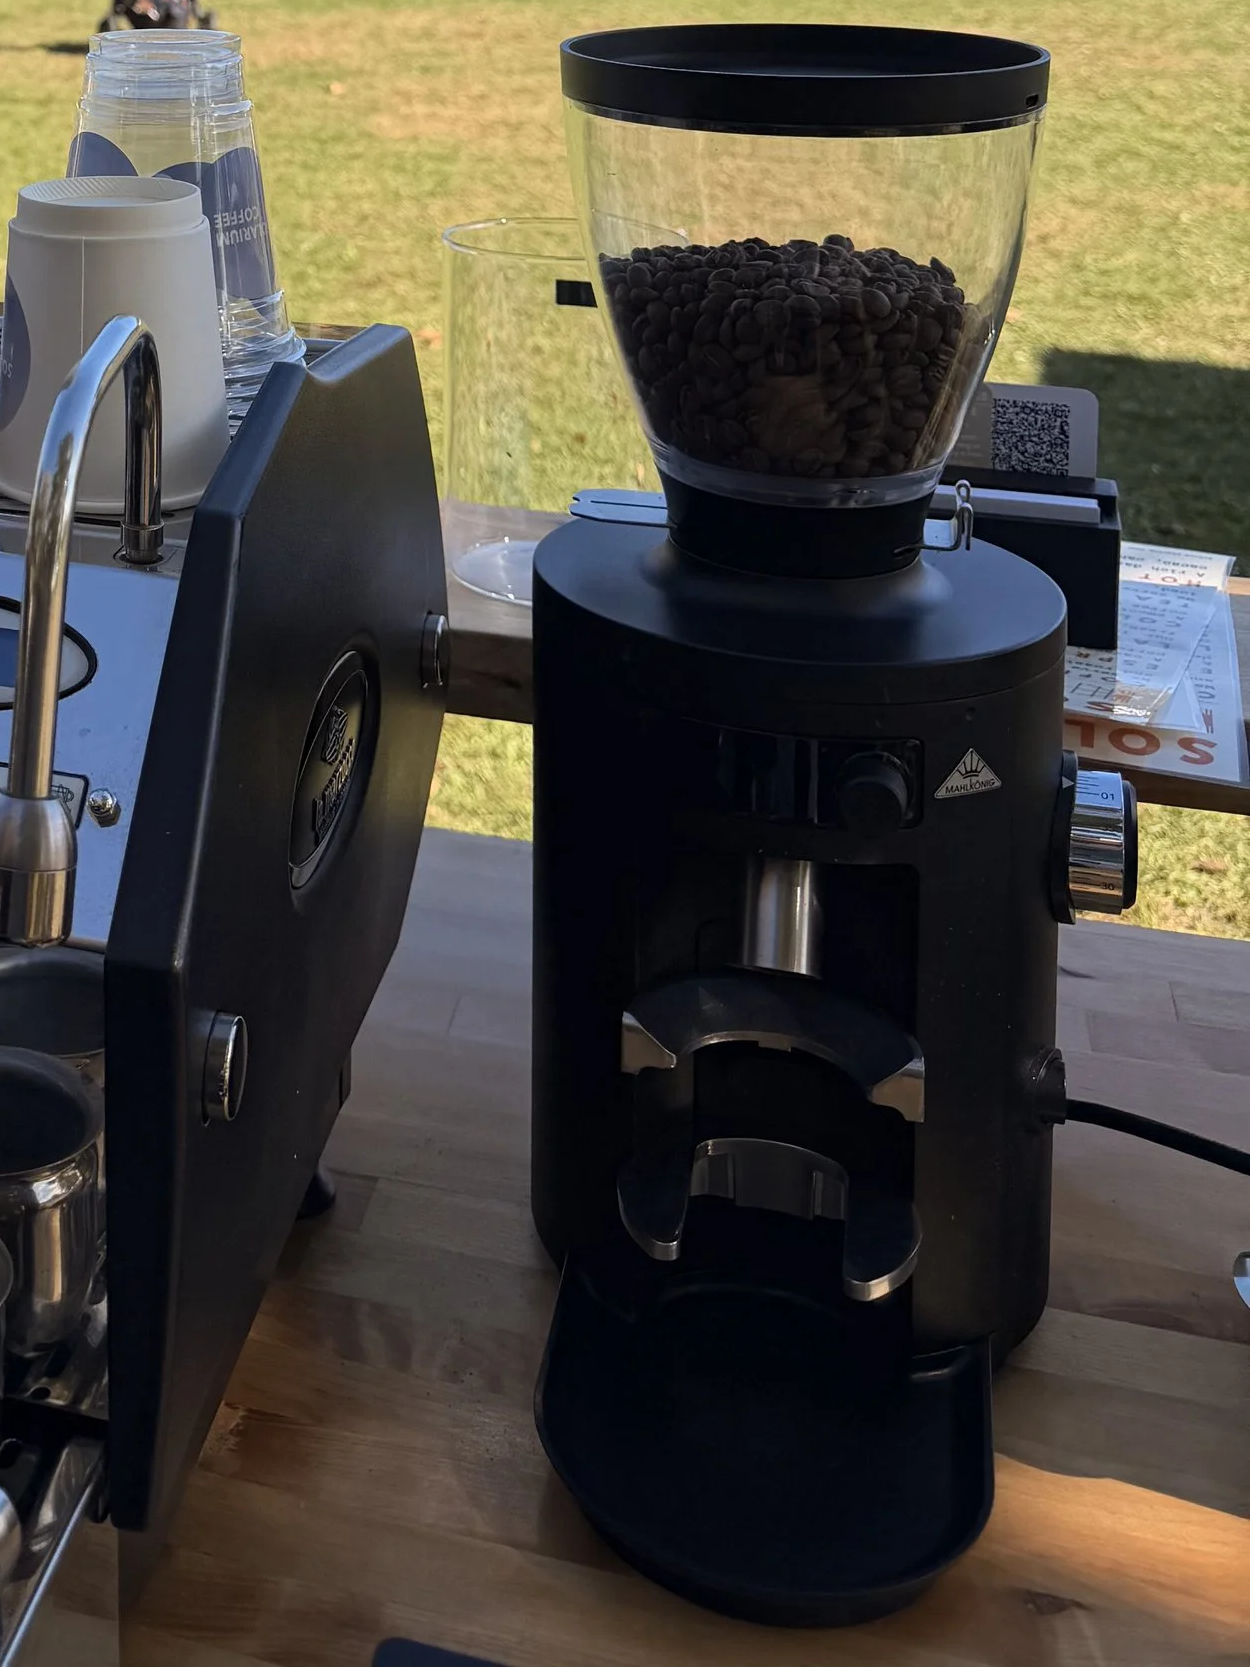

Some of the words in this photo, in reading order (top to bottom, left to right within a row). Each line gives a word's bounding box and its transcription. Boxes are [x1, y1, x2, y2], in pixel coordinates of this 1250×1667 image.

[1138, 573, 1201, 587] HOT
[945, 778, 996, 795] MAHLKÖNIG
[1100, 792, 1115, 801] 01
